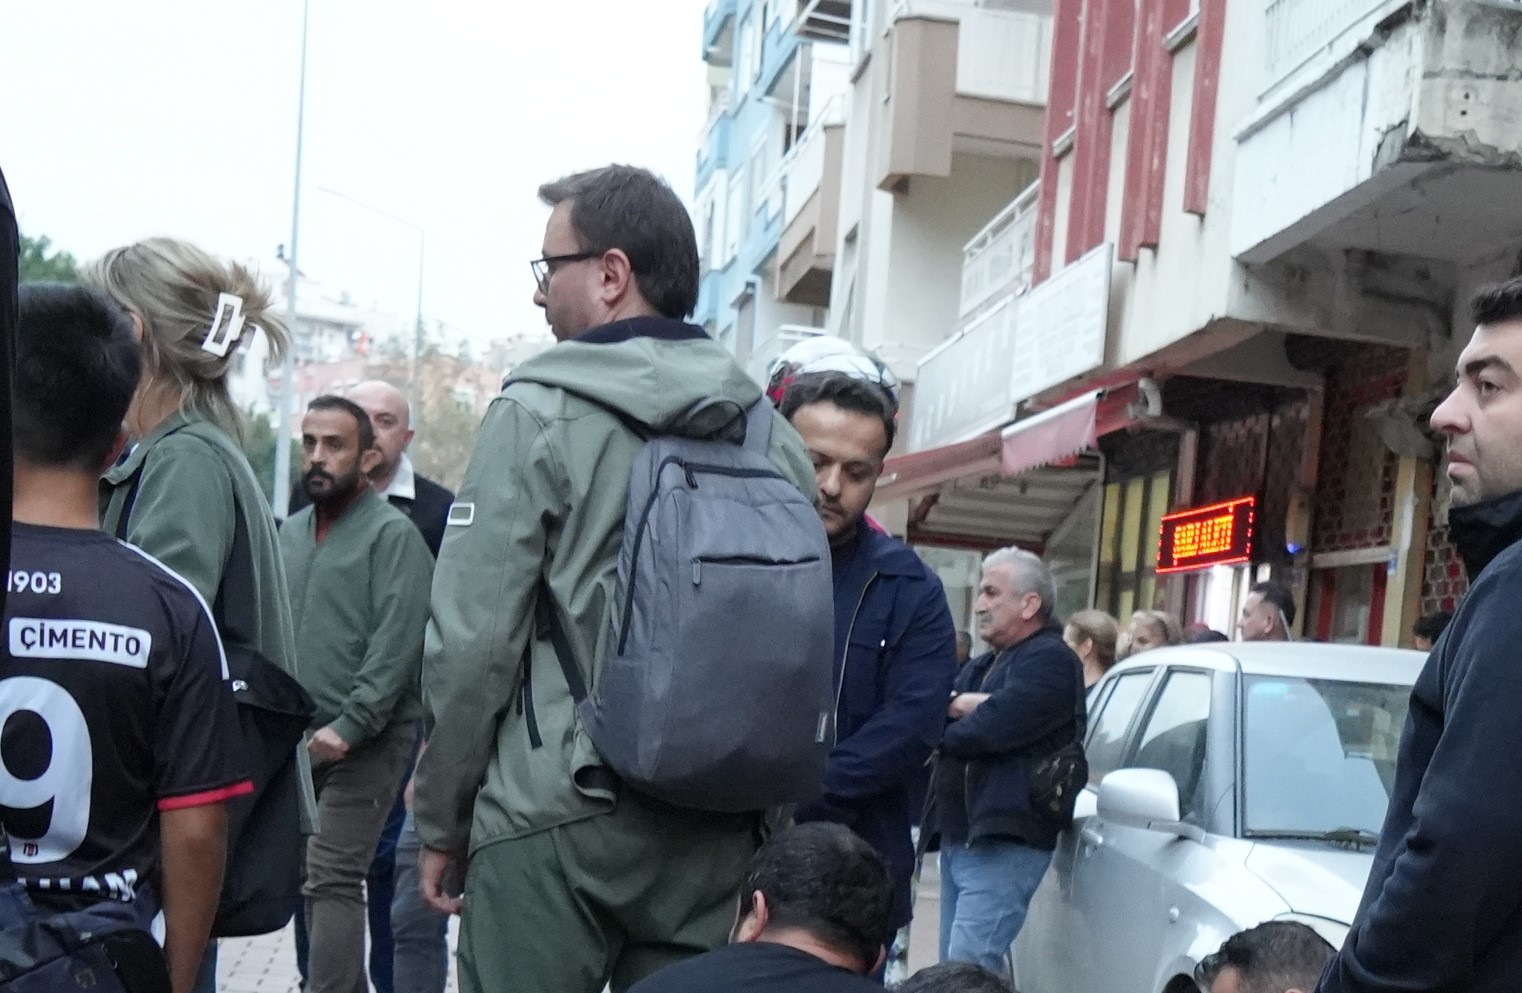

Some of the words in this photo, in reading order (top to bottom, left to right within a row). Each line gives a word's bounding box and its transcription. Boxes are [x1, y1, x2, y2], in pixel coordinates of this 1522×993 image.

[7, 570, 62, 594] 1903
[20, 622, 141, 655] ÇİMENTO
[0, 676, 92, 864] 9
